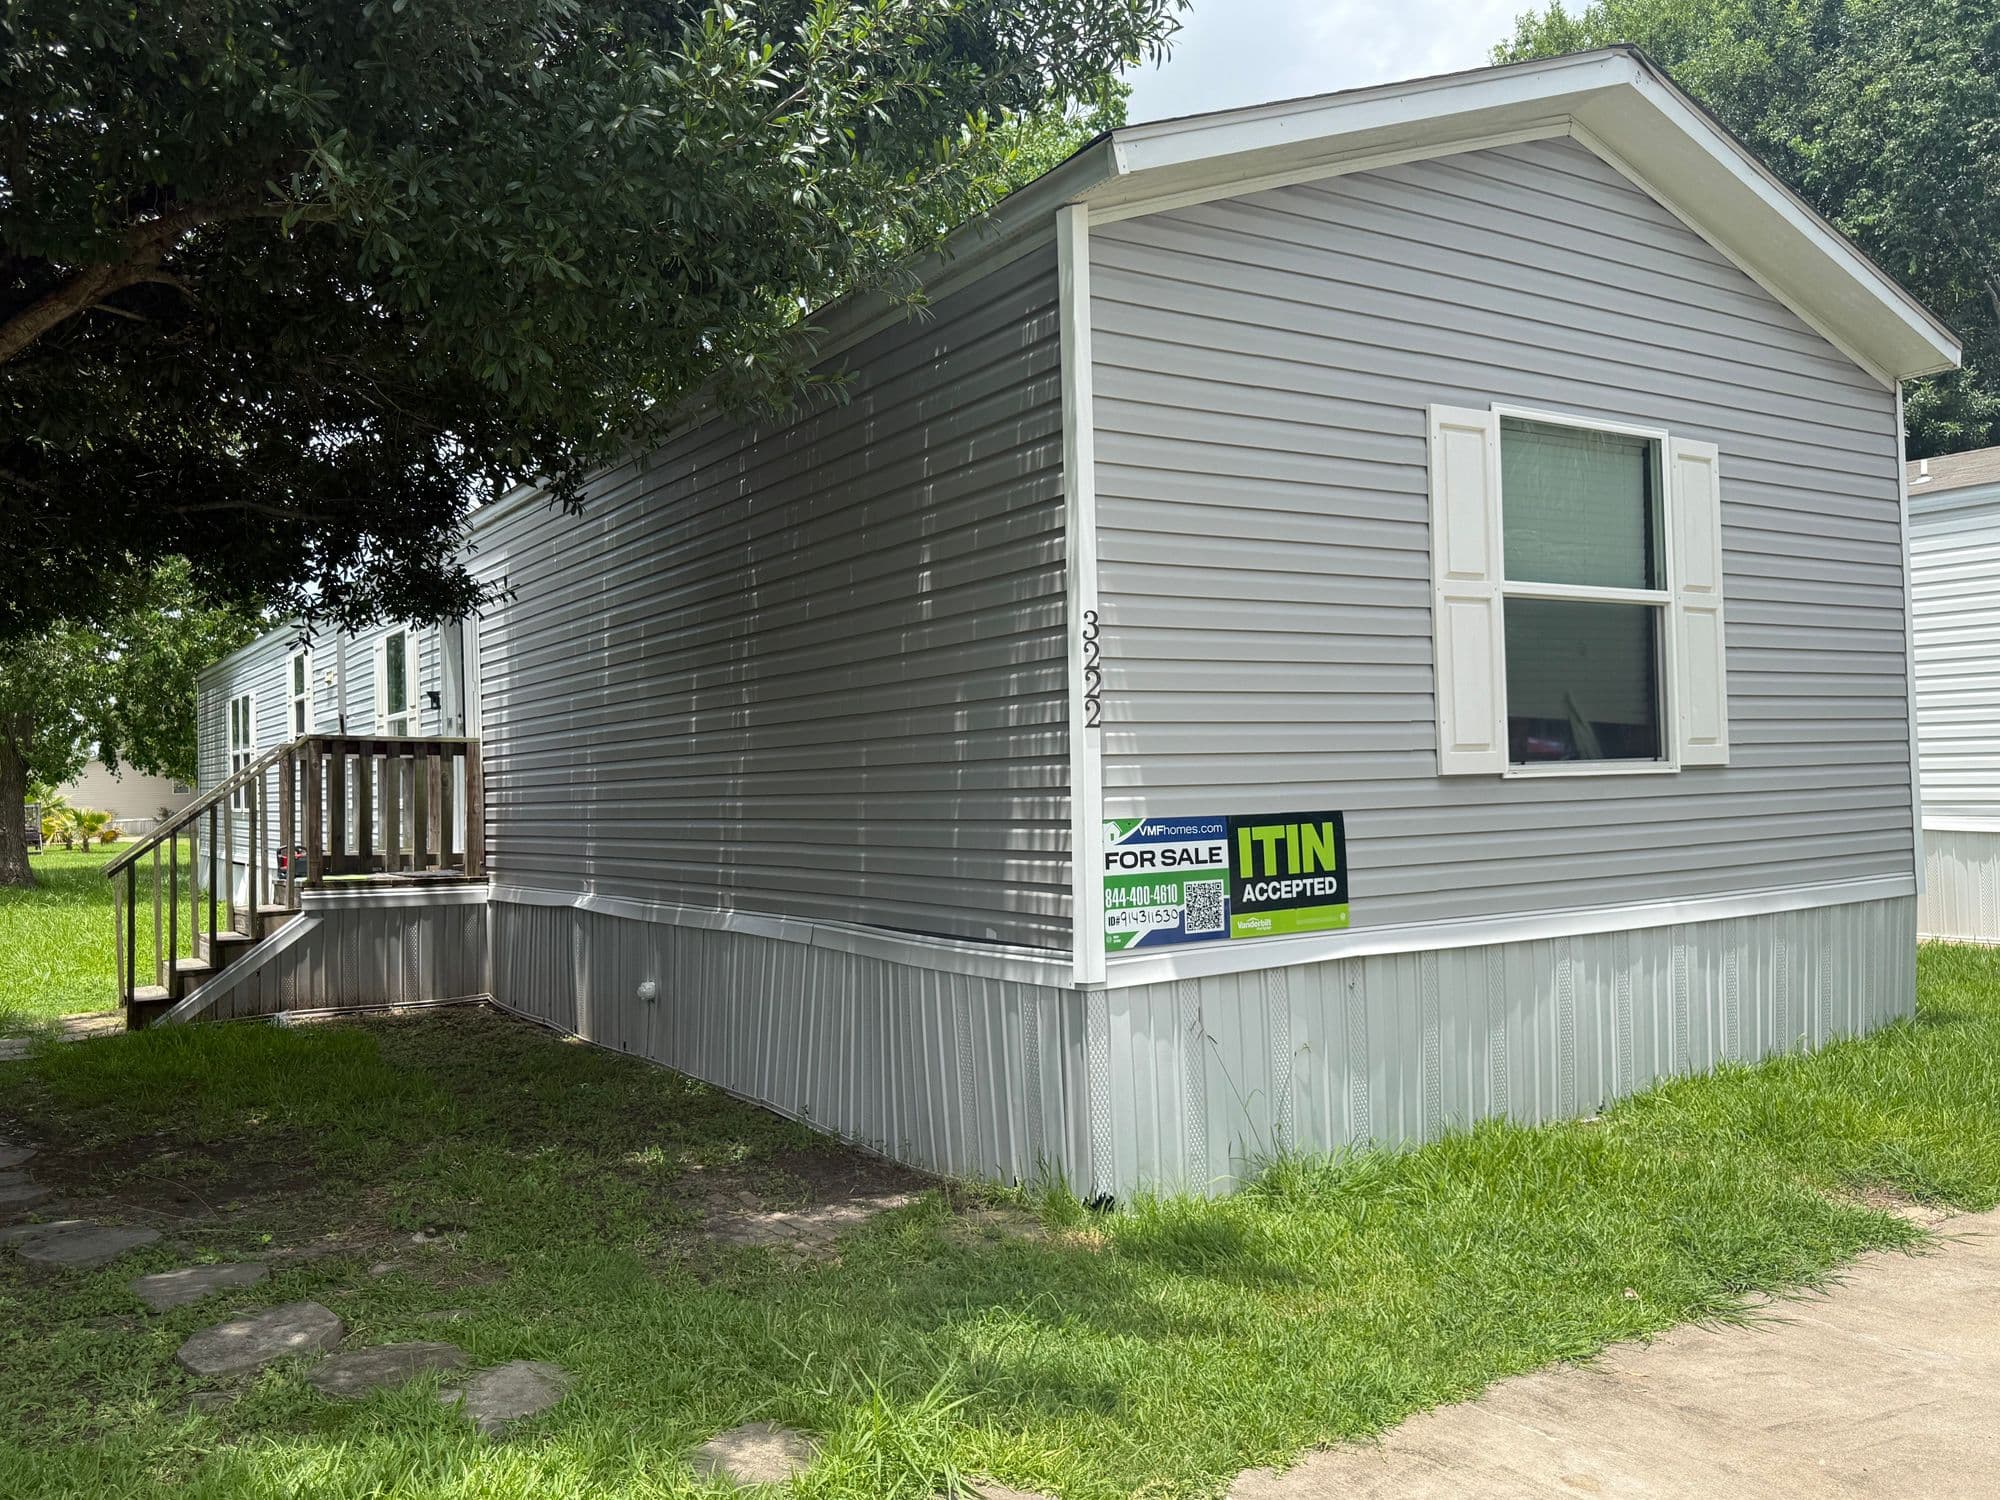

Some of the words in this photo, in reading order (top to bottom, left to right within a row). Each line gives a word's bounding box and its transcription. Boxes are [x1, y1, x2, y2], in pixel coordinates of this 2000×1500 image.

[1082, 610, 1102, 728] 3222
[1140, 824, 1223, 836] VMFhomes.com
[1105, 850, 1156, 870] FOR
[1160, 846, 1222, 867] SALE
[1237, 821, 1336, 878] ITIN
[1105, 883, 1178, 908] 844-400-4610
[1242, 876, 1337, 903] ACCEPTED
